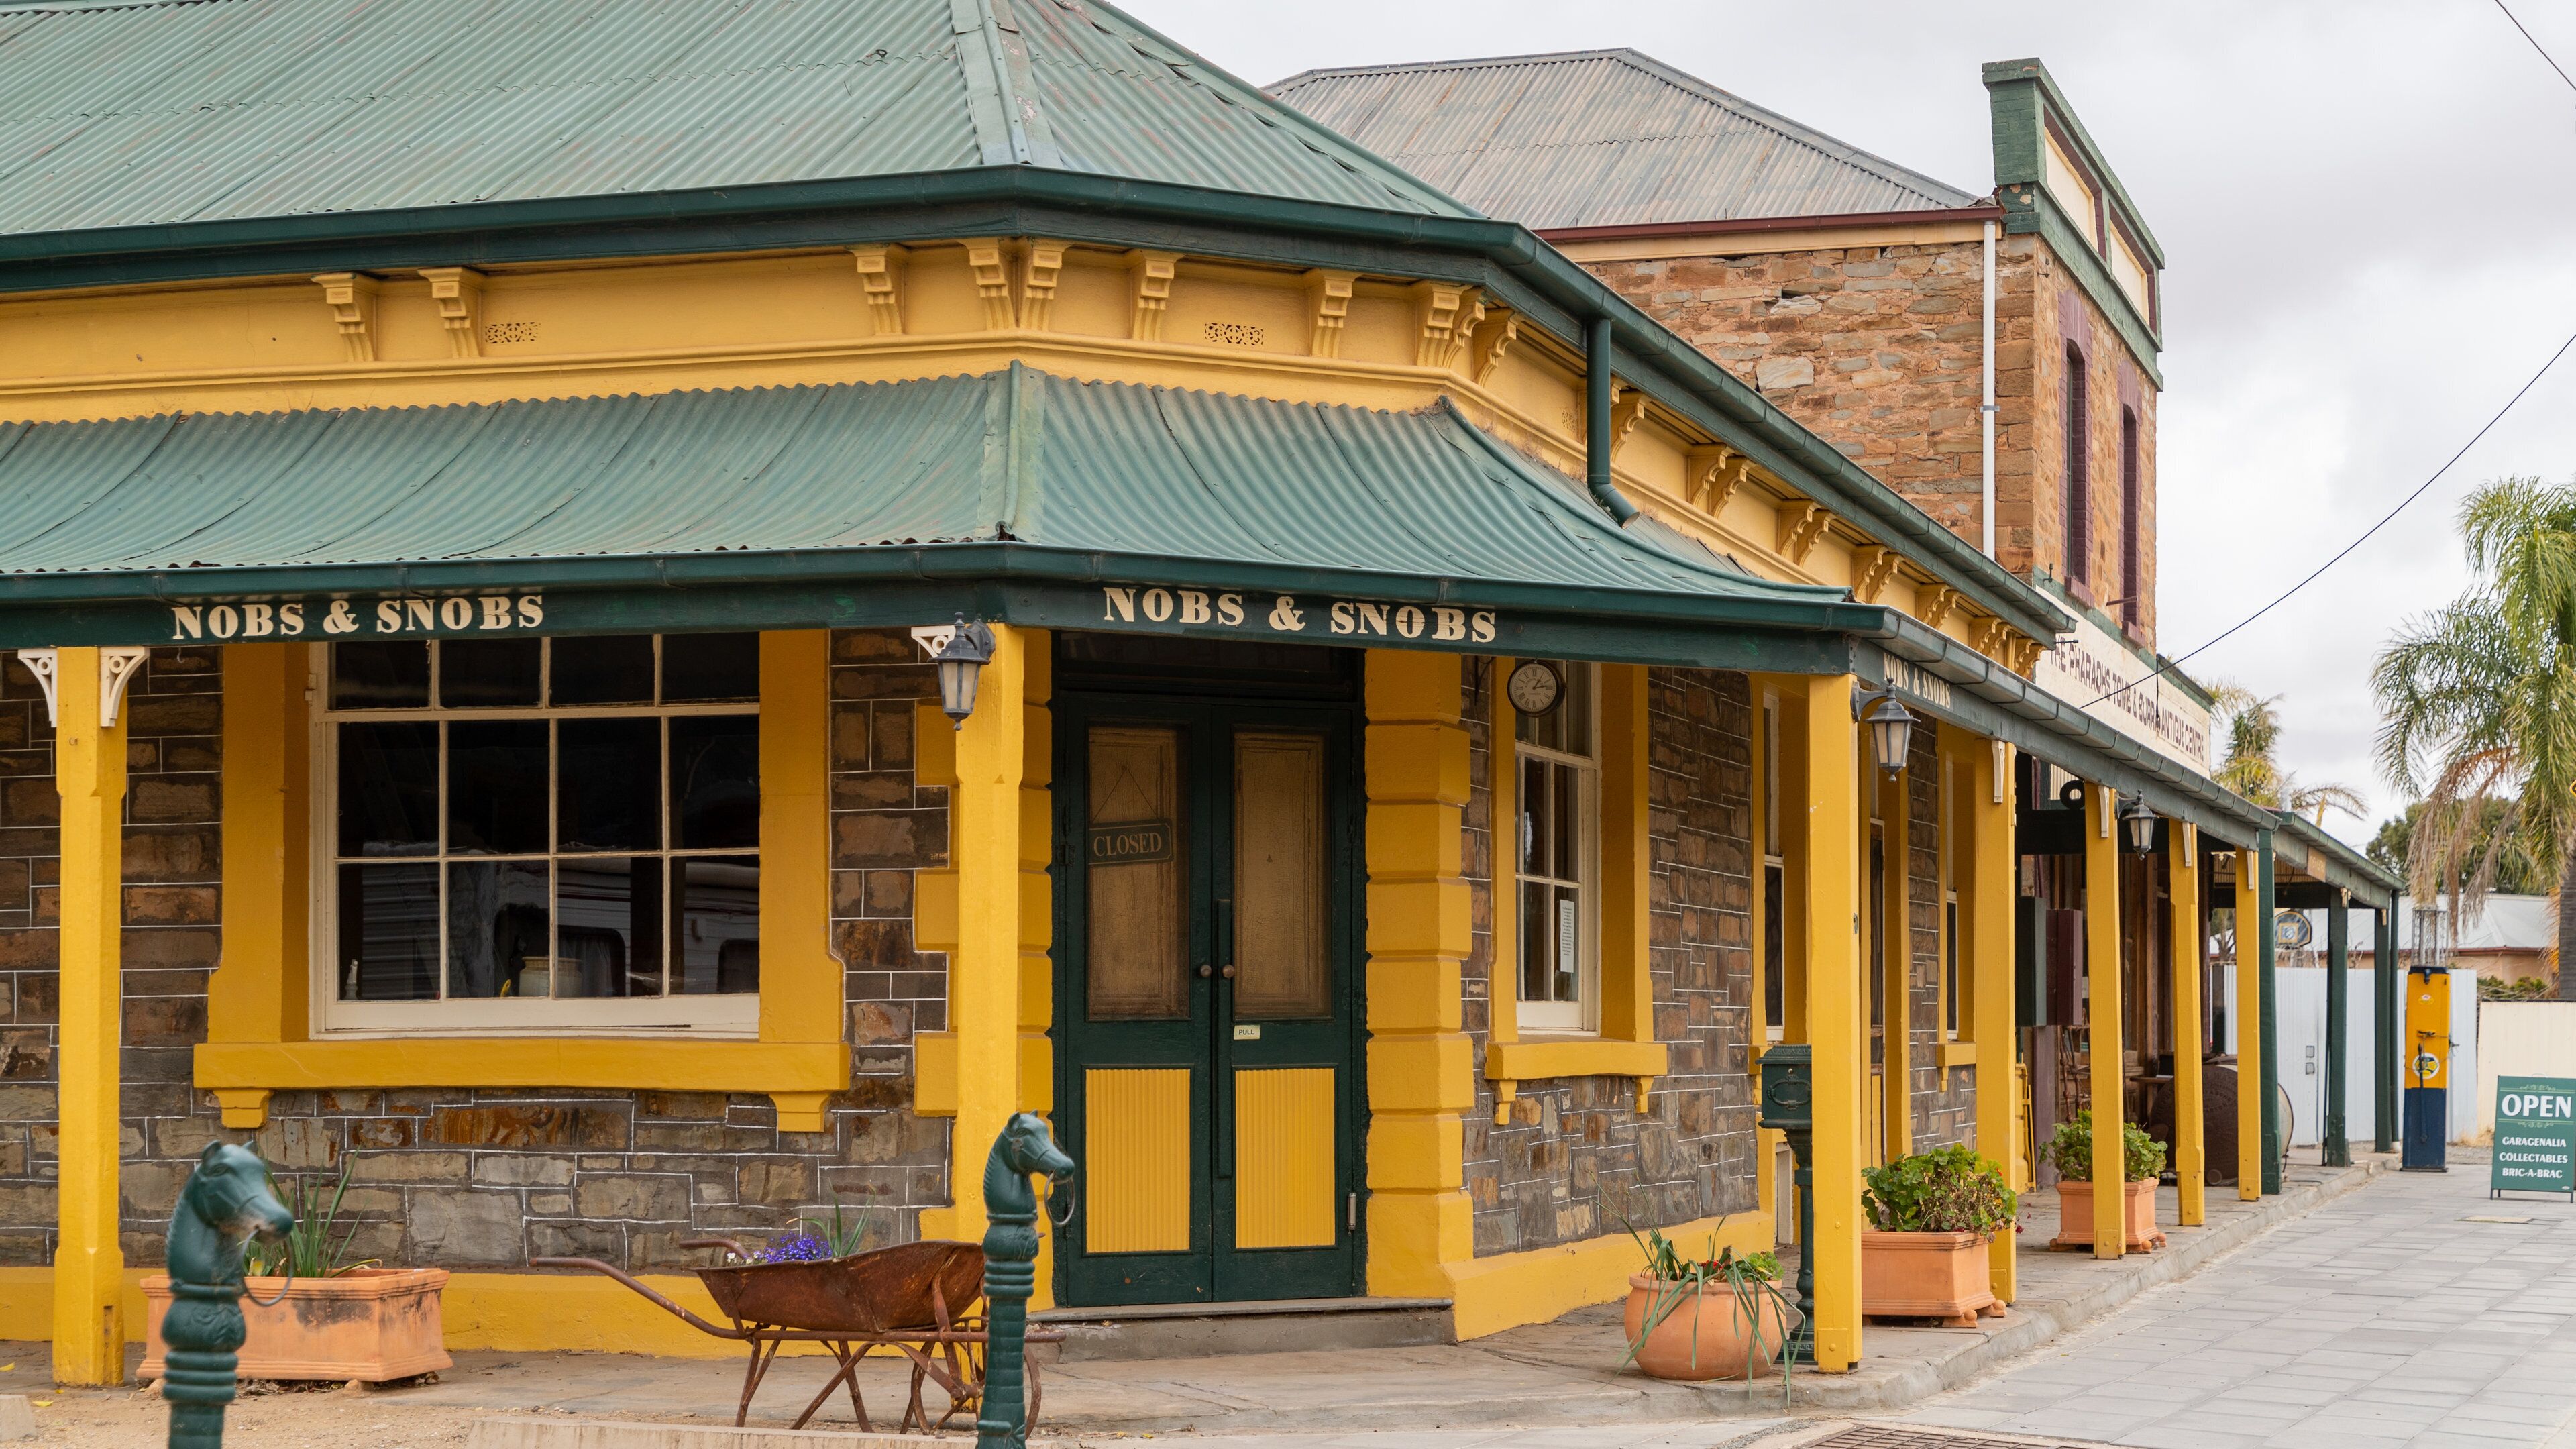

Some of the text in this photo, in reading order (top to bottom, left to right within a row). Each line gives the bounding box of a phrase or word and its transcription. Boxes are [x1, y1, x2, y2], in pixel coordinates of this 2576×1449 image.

[172, 594, 543, 640] NOBS & SNOBS
[1102, 587, 1497, 643] NOBS & SNOBS
[1884, 651, 1951, 709] NOBS & SNOBS
[2069, 643, 2111, 701] PHARAOHS
[2112, 672, 2131, 714] TOMB
[2161, 706, 2184, 747] ANTIQUE
[2185, 724, 2204, 762] CENTRE
[1093, 832, 1163, 857] CLOSED
[2502, 1094, 2571, 1118] OPEN
[2502, 1136, 2567, 1148] GARAGENALIA
[2499, 1152, 2568, 1163] COLLECTABLES
[2502, 1167, 2563, 1179] BRIC-A-BRAC
